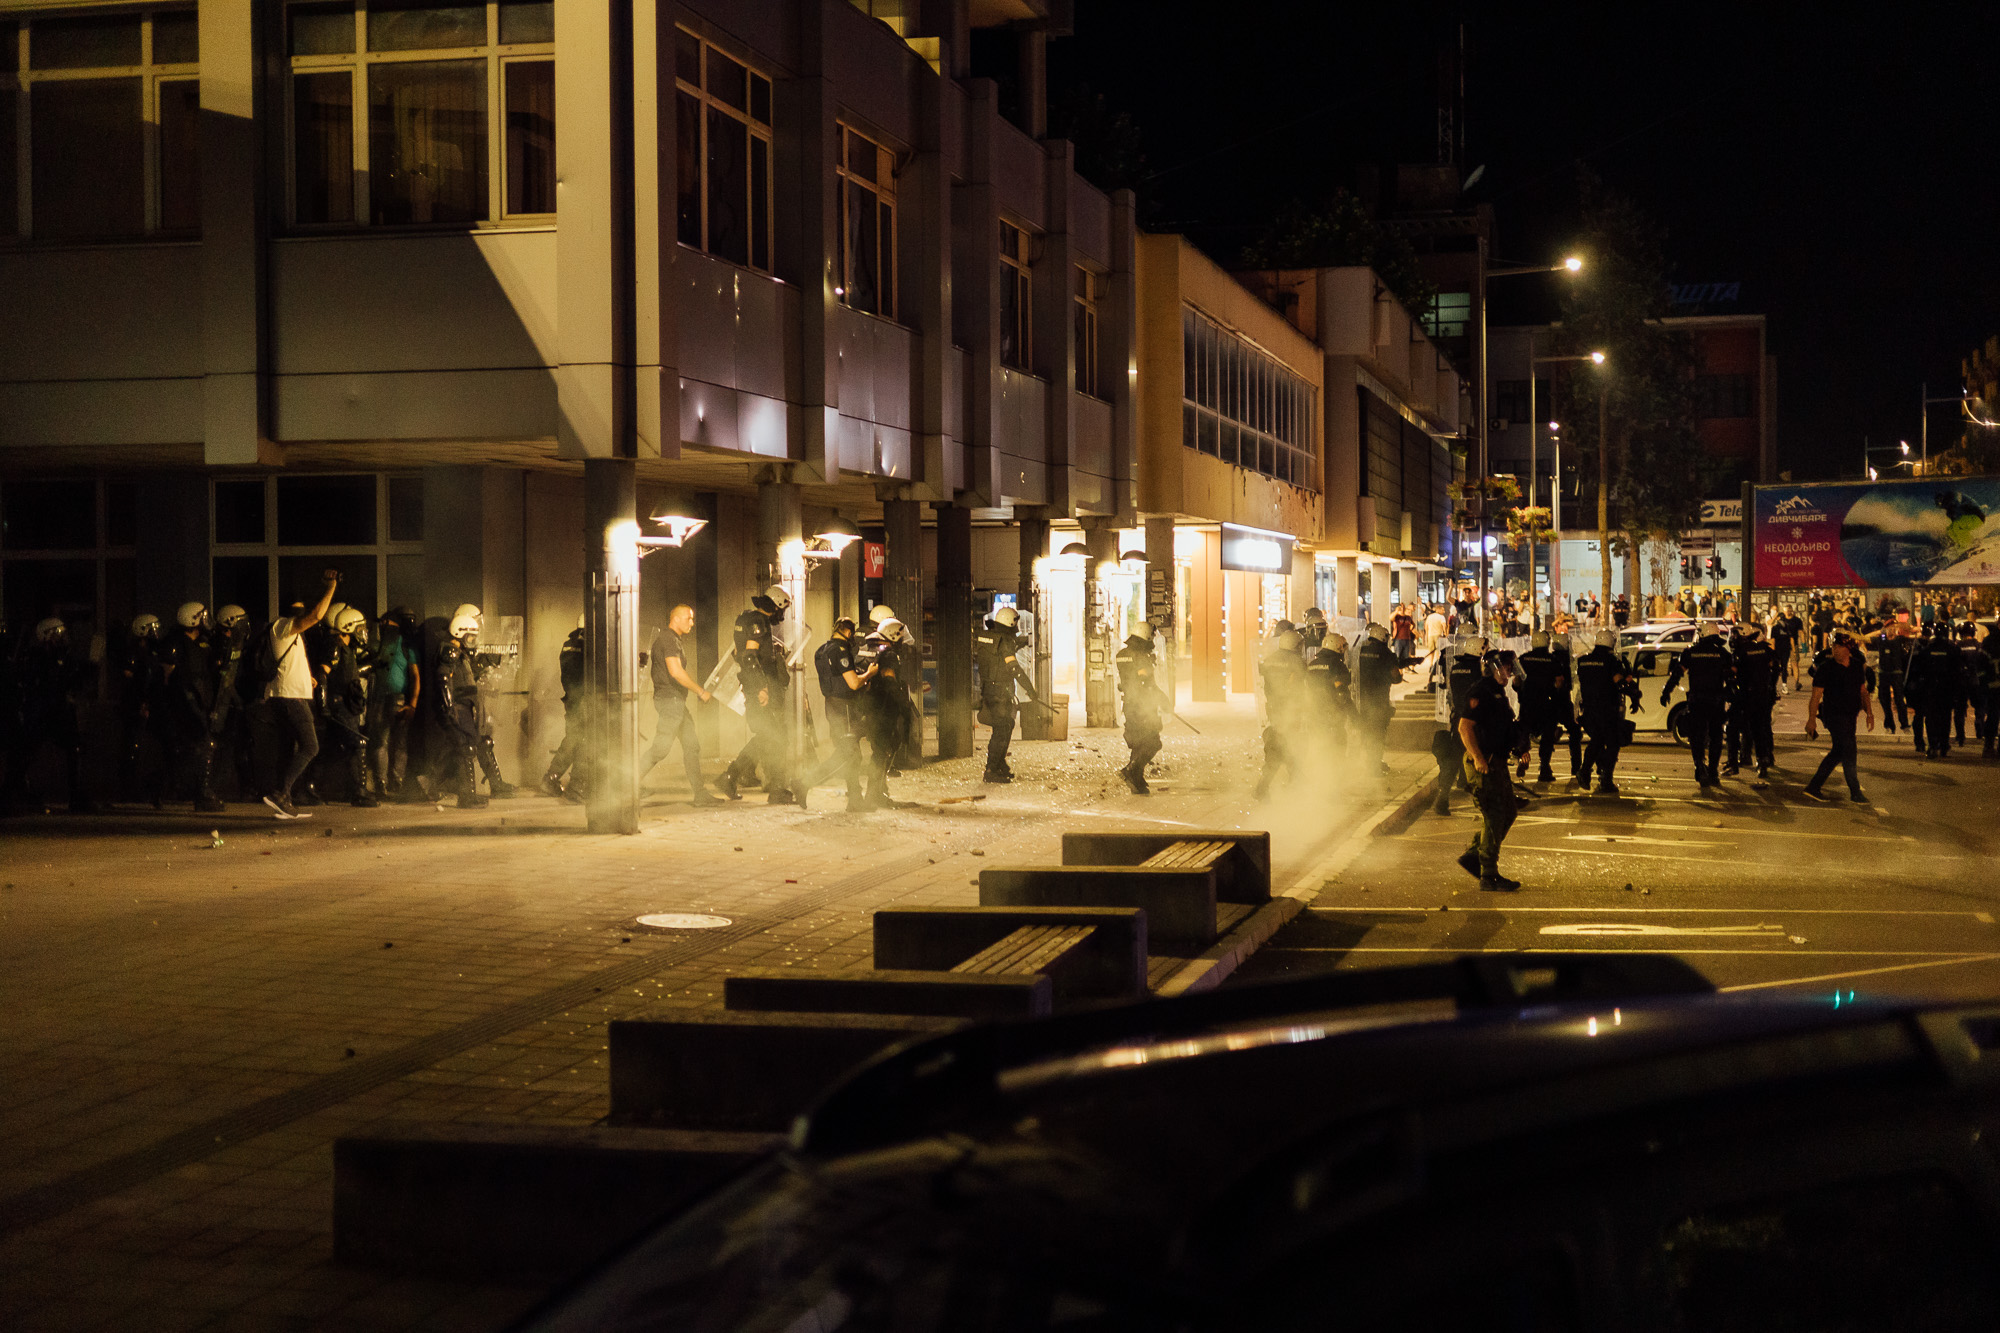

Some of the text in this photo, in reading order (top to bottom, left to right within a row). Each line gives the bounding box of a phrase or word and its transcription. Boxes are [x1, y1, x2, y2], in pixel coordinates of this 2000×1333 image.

[1768, 514, 1828, 524] ДИВЧИБАРЕ
[1764, 542, 1831, 554] НЕОДОЉИВО
[1781, 556, 1814, 566] БЛИЗУ
